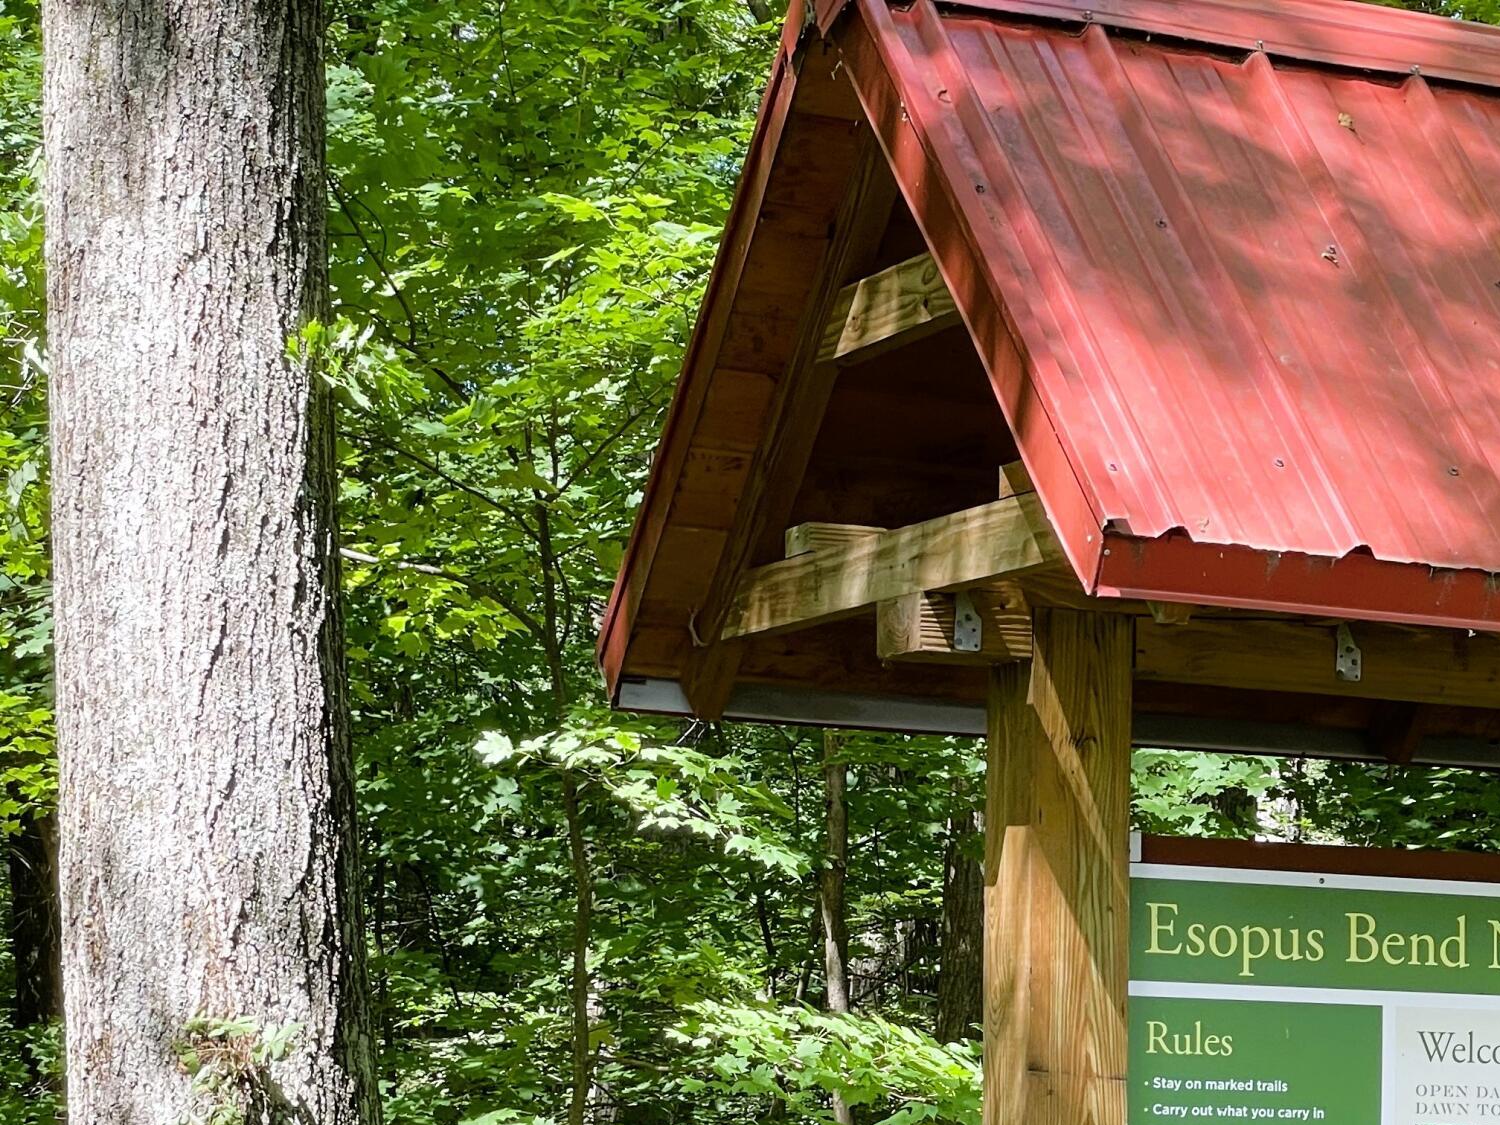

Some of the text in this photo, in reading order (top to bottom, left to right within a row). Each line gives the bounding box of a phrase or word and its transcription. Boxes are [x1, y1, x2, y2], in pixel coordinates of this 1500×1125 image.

[1144, 902, 1324, 976] Esopus
[1345, 912, 1470, 968] Bend
[1146, 1020, 1232, 1056] Rules
[1152, 1076, 1287, 1091] Stay on marked trails
[1415, 1084, 1467, 1097] OPEN
[1152, 1103, 1324, 1120] Carry out what you carry in
[1416, 1102, 1469, 1115] DAWN
